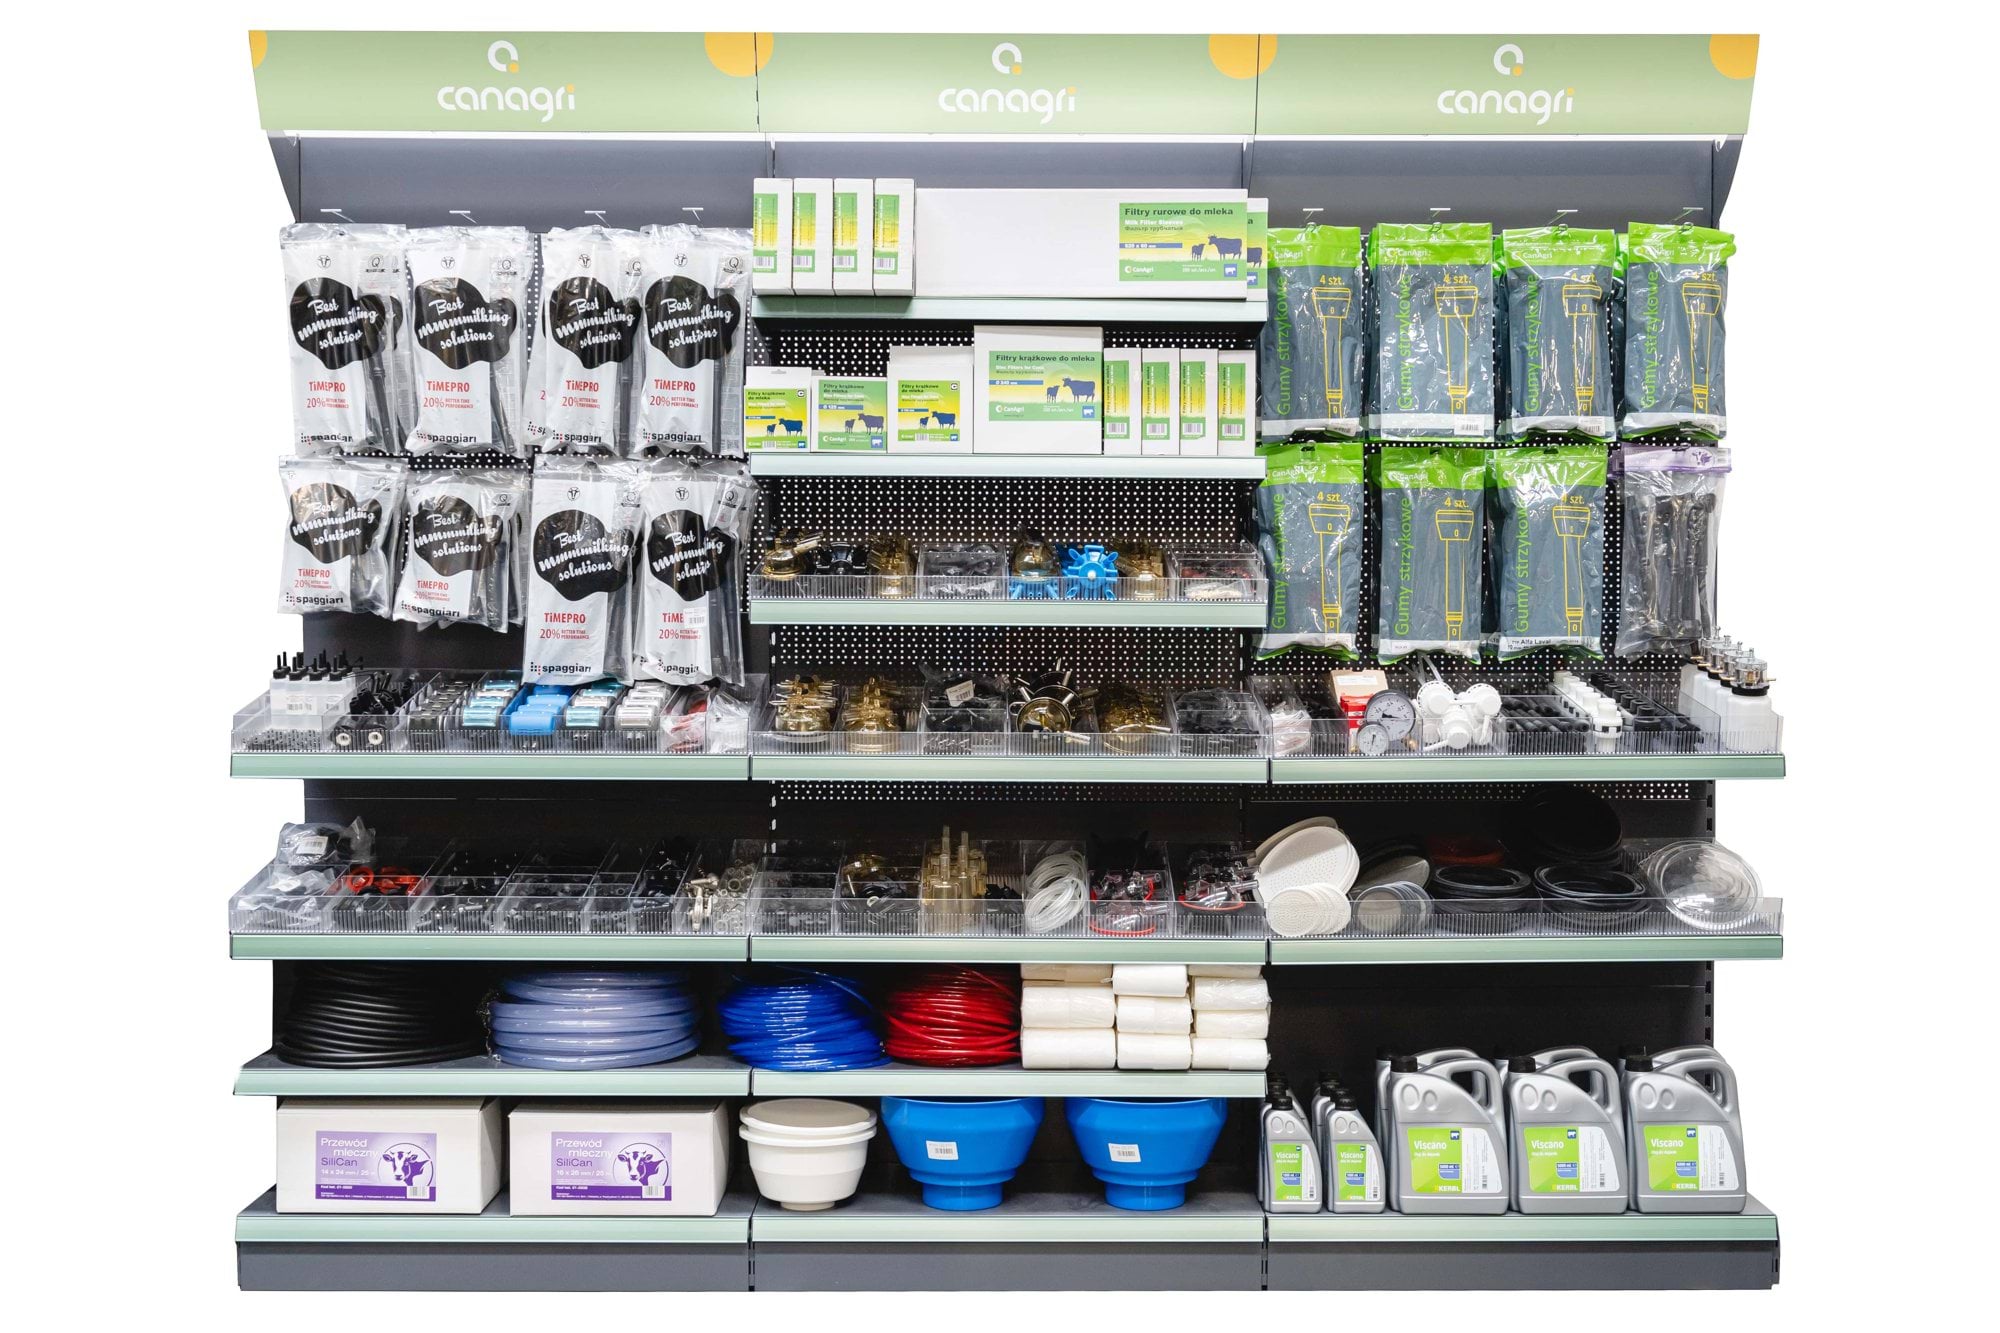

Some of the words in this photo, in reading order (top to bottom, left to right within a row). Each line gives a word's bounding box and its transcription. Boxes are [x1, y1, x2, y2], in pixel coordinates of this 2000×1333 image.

[437, 83, 576, 122] canagri
[938, 86, 1077, 125] canagri
[1437, 87, 1575, 126] canagri
[1125, 208, 1150, 217] Filtry
[1319, 274, 1326, 284] 4
[1328, 276, 1345, 285] szt.
[1453, 274, 1471, 284] szt.
[1581, 274, 1597, 284] szt.
[1702, 273, 1718, 282] szt.
[307, 298, 339, 315] Best
[429, 296, 464, 315] Best
[569, 297, 599, 315] Best
[661, 297, 692, 314] Best
[1525, 274, 1542, 358] strzykowe
[1643, 271, 1660, 354] strzykowe
[1276, 277, 1293, 361] strzykowe
[440, 328, 494, 350] solutions
[1397, 358, 1413, 409] Gumy
[1525, 358, 1543, 412] Gumy
[1641, 354, 1660, 408] Gumy
[1277, 363, 1293, 416] Gumy
[423, 397, 445, 408] 20%
[650, 395, 671, 407] 20%
[428, 432, 477, 444] spaggiari
[651, 432, 702, 443] spaggiari
[1317, 491, 1324, 500] 4
[1327, 493, 1343, 502] szt.
[1570, 496, 1585, 505] szt.
[1445, 498, 1451, 506] 4
[1454, 500, 1468, 508] szt.
[427, 512, 461, 528] Best
[313, 527, 361, 546] solutions
[553, 529, 584, 548] Best
[664, 529, 696, 548] Best
[1397, 498, 1414, 581] strzykowe
[1516, 500, 1531, 577] strzykow
[432, 541, 482, 558] solutions
[558, 560, 614, 581] solutions
[294, 580, 311, 589] 20%
[297, 594, 344, 606] spaggiari
[1272, 579, 1288, 629] Gumy
[1515, 577, 1533, 632] Gumy
[412, 606, 460, 617] spaggiari
[1395, 582, 1413, 636] Gumy
[663, 613, 684, 623] TiME
[540, 629, 560, 639] 20%
[659, 629, 679, 639] 20%
[542, 663, 592, 675] spaggiari
[321, 1138, 367, 1148] Przewód
[556, 1138, 601, 1148] Przewód
[1414, 1141, 1447, 1150] Viscano
[1531, 1140, 1564, 1149] Viscano
[1651, 1139, 1684, 1147] Viscano
[333, 1149, 379, 1159] mleczny
[568, 1149, 613, 1159] mleczny
[321, 1158, 358, 1167] SiliCan
[556, 1158, 593, 1167] SiliCan
